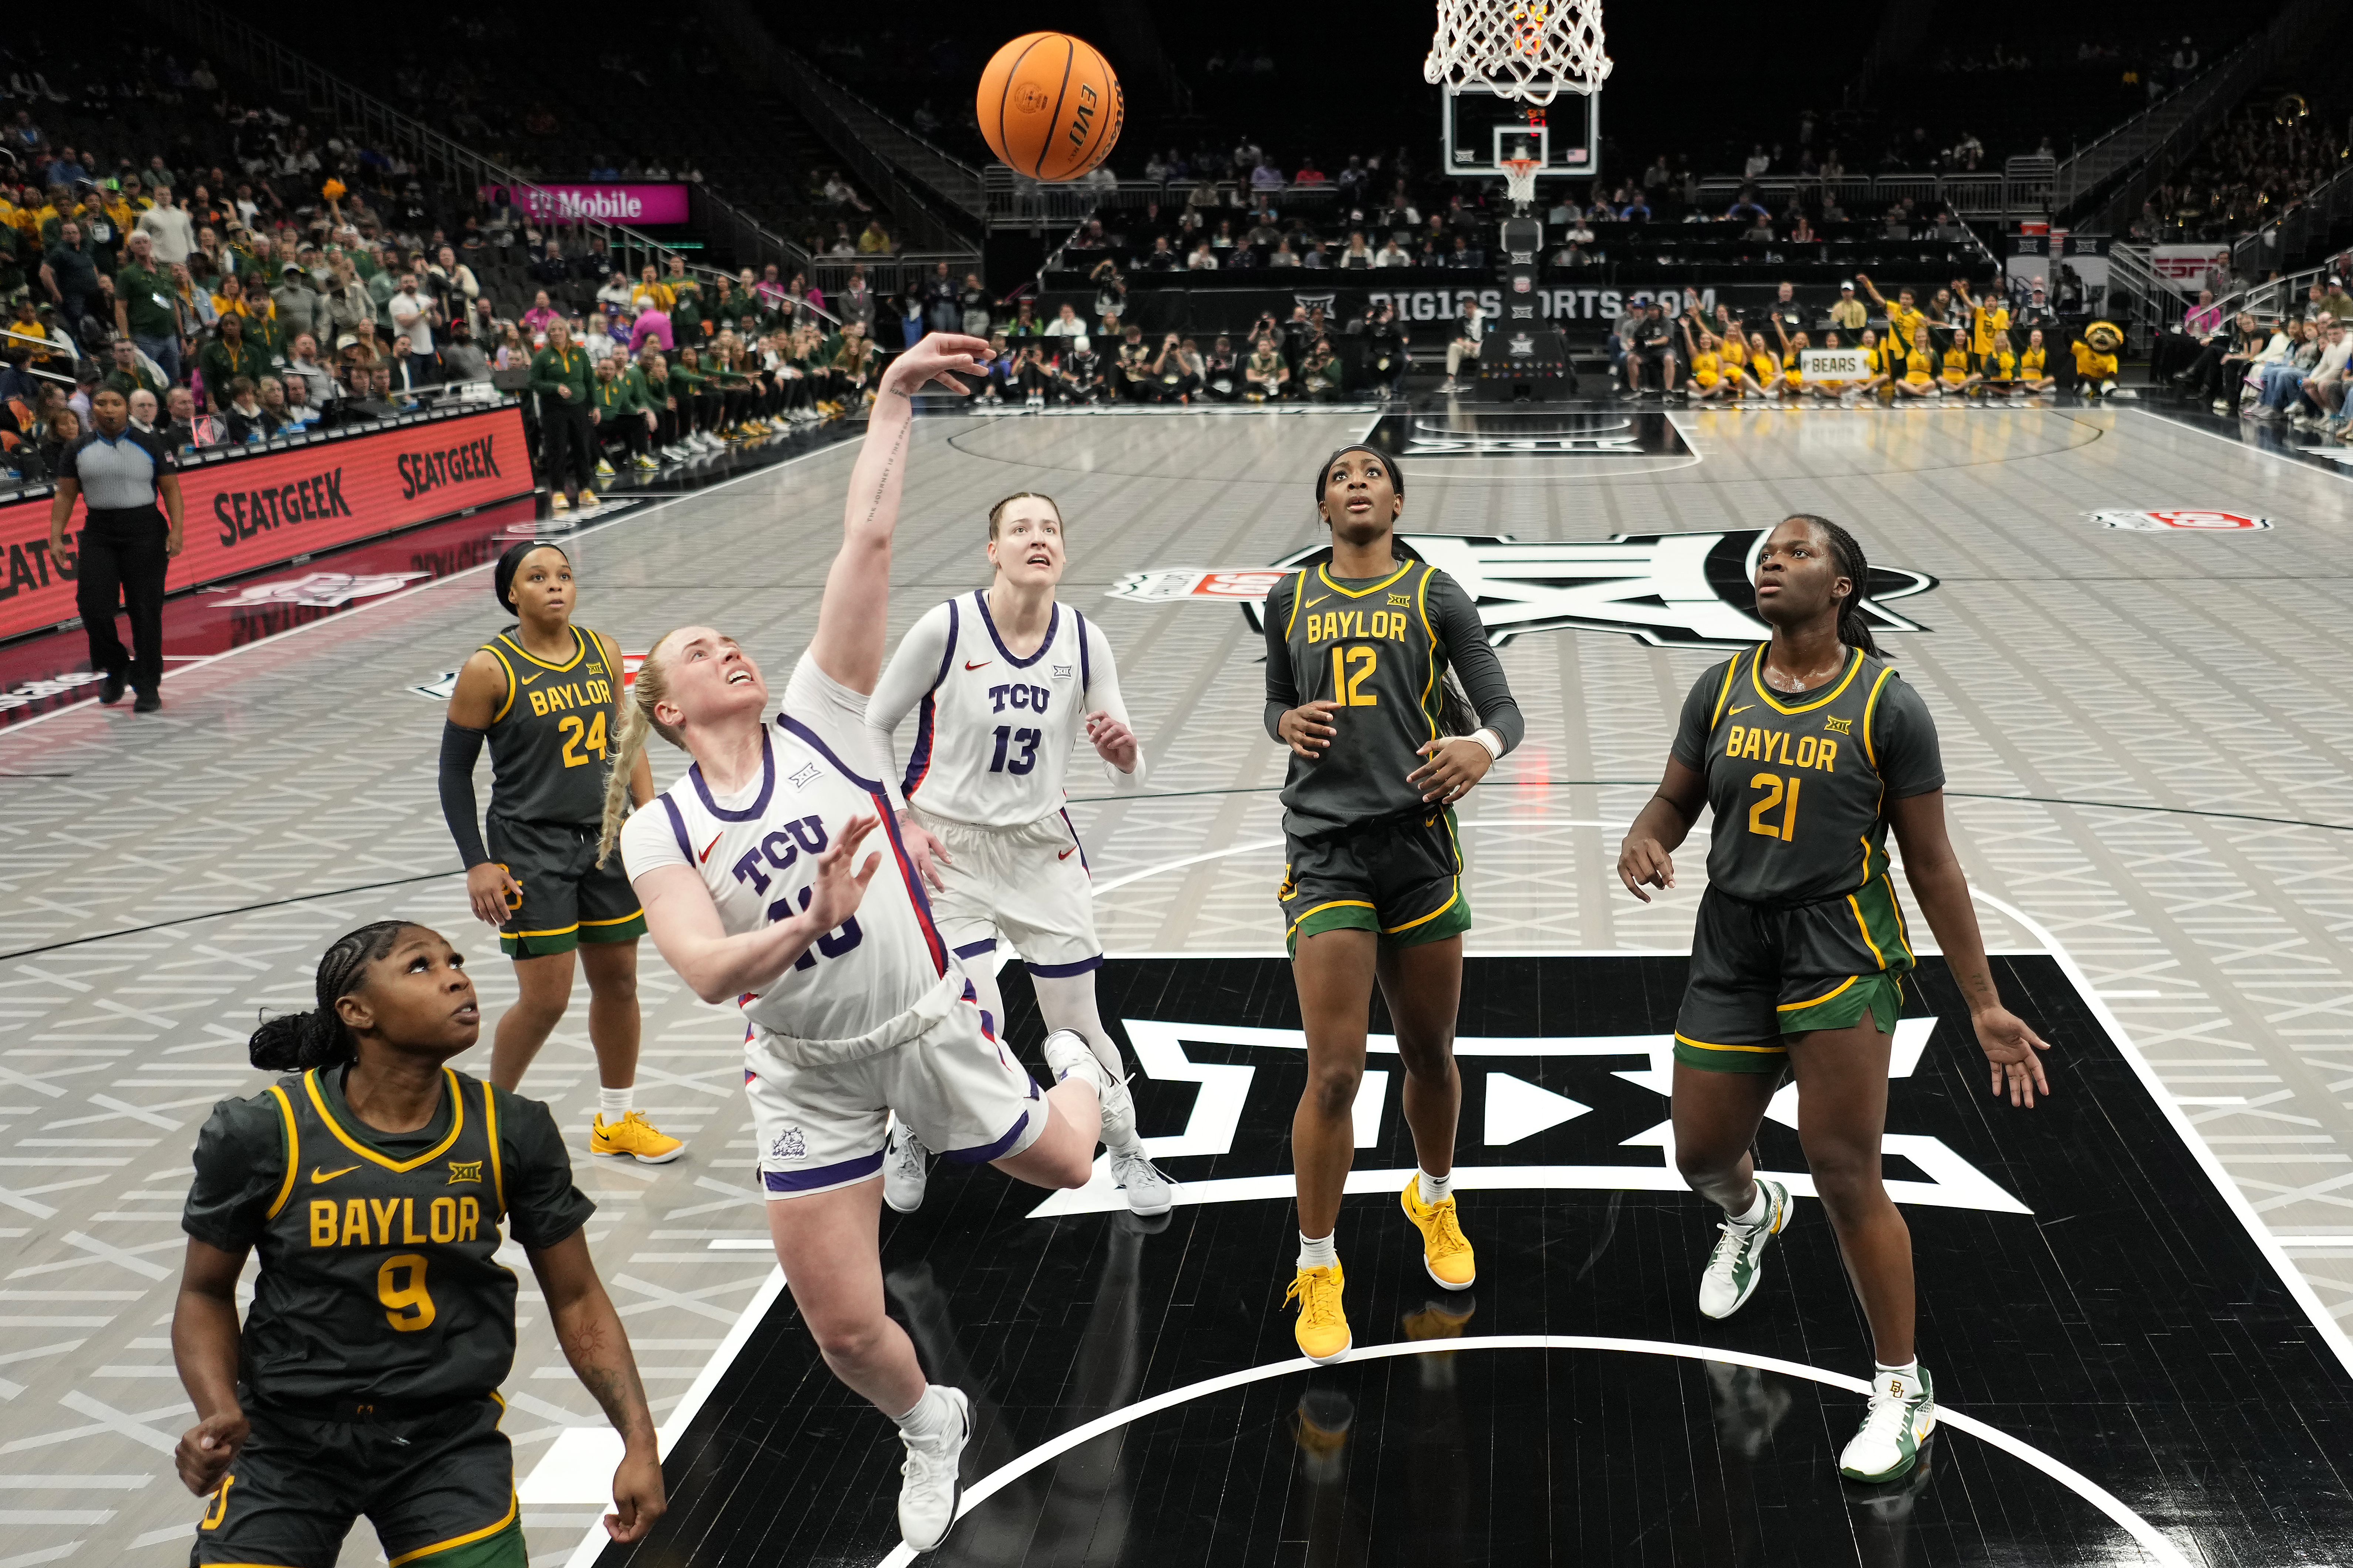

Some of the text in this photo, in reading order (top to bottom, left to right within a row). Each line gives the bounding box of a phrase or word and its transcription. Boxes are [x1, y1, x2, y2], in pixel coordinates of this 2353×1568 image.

[1069, 82, 1097, 147] EVO
[558, 190, 642, 218] Mobile
[1813, 357, 1855, 372] BEARS
[397, 434, 501, 500] SEATGEEK
[874, 468, 890, 505] JOURNEY
[213, 467, 352, 547] SEATGEEK
[1307, 611, 1407, 644] BAYLOR
[529, 680, 613, 716] BAYLOR
[989, 684, 1050, 715] TCU
[1333, 646, 1377, 706] 12
[559, 711, 607, 768] 24
[989, 726, 1042, 776] 13
[1726, 726, 1837, 772] BAYLOR
[1749, 773, 1801, 842] 21
[732, 815, 828, 897] TCU
[310, 1197, 479, 1248] BAYLOR
[378, 1253, 436, 1332] 9
[1890, 1380, 1904, 1398] BU
